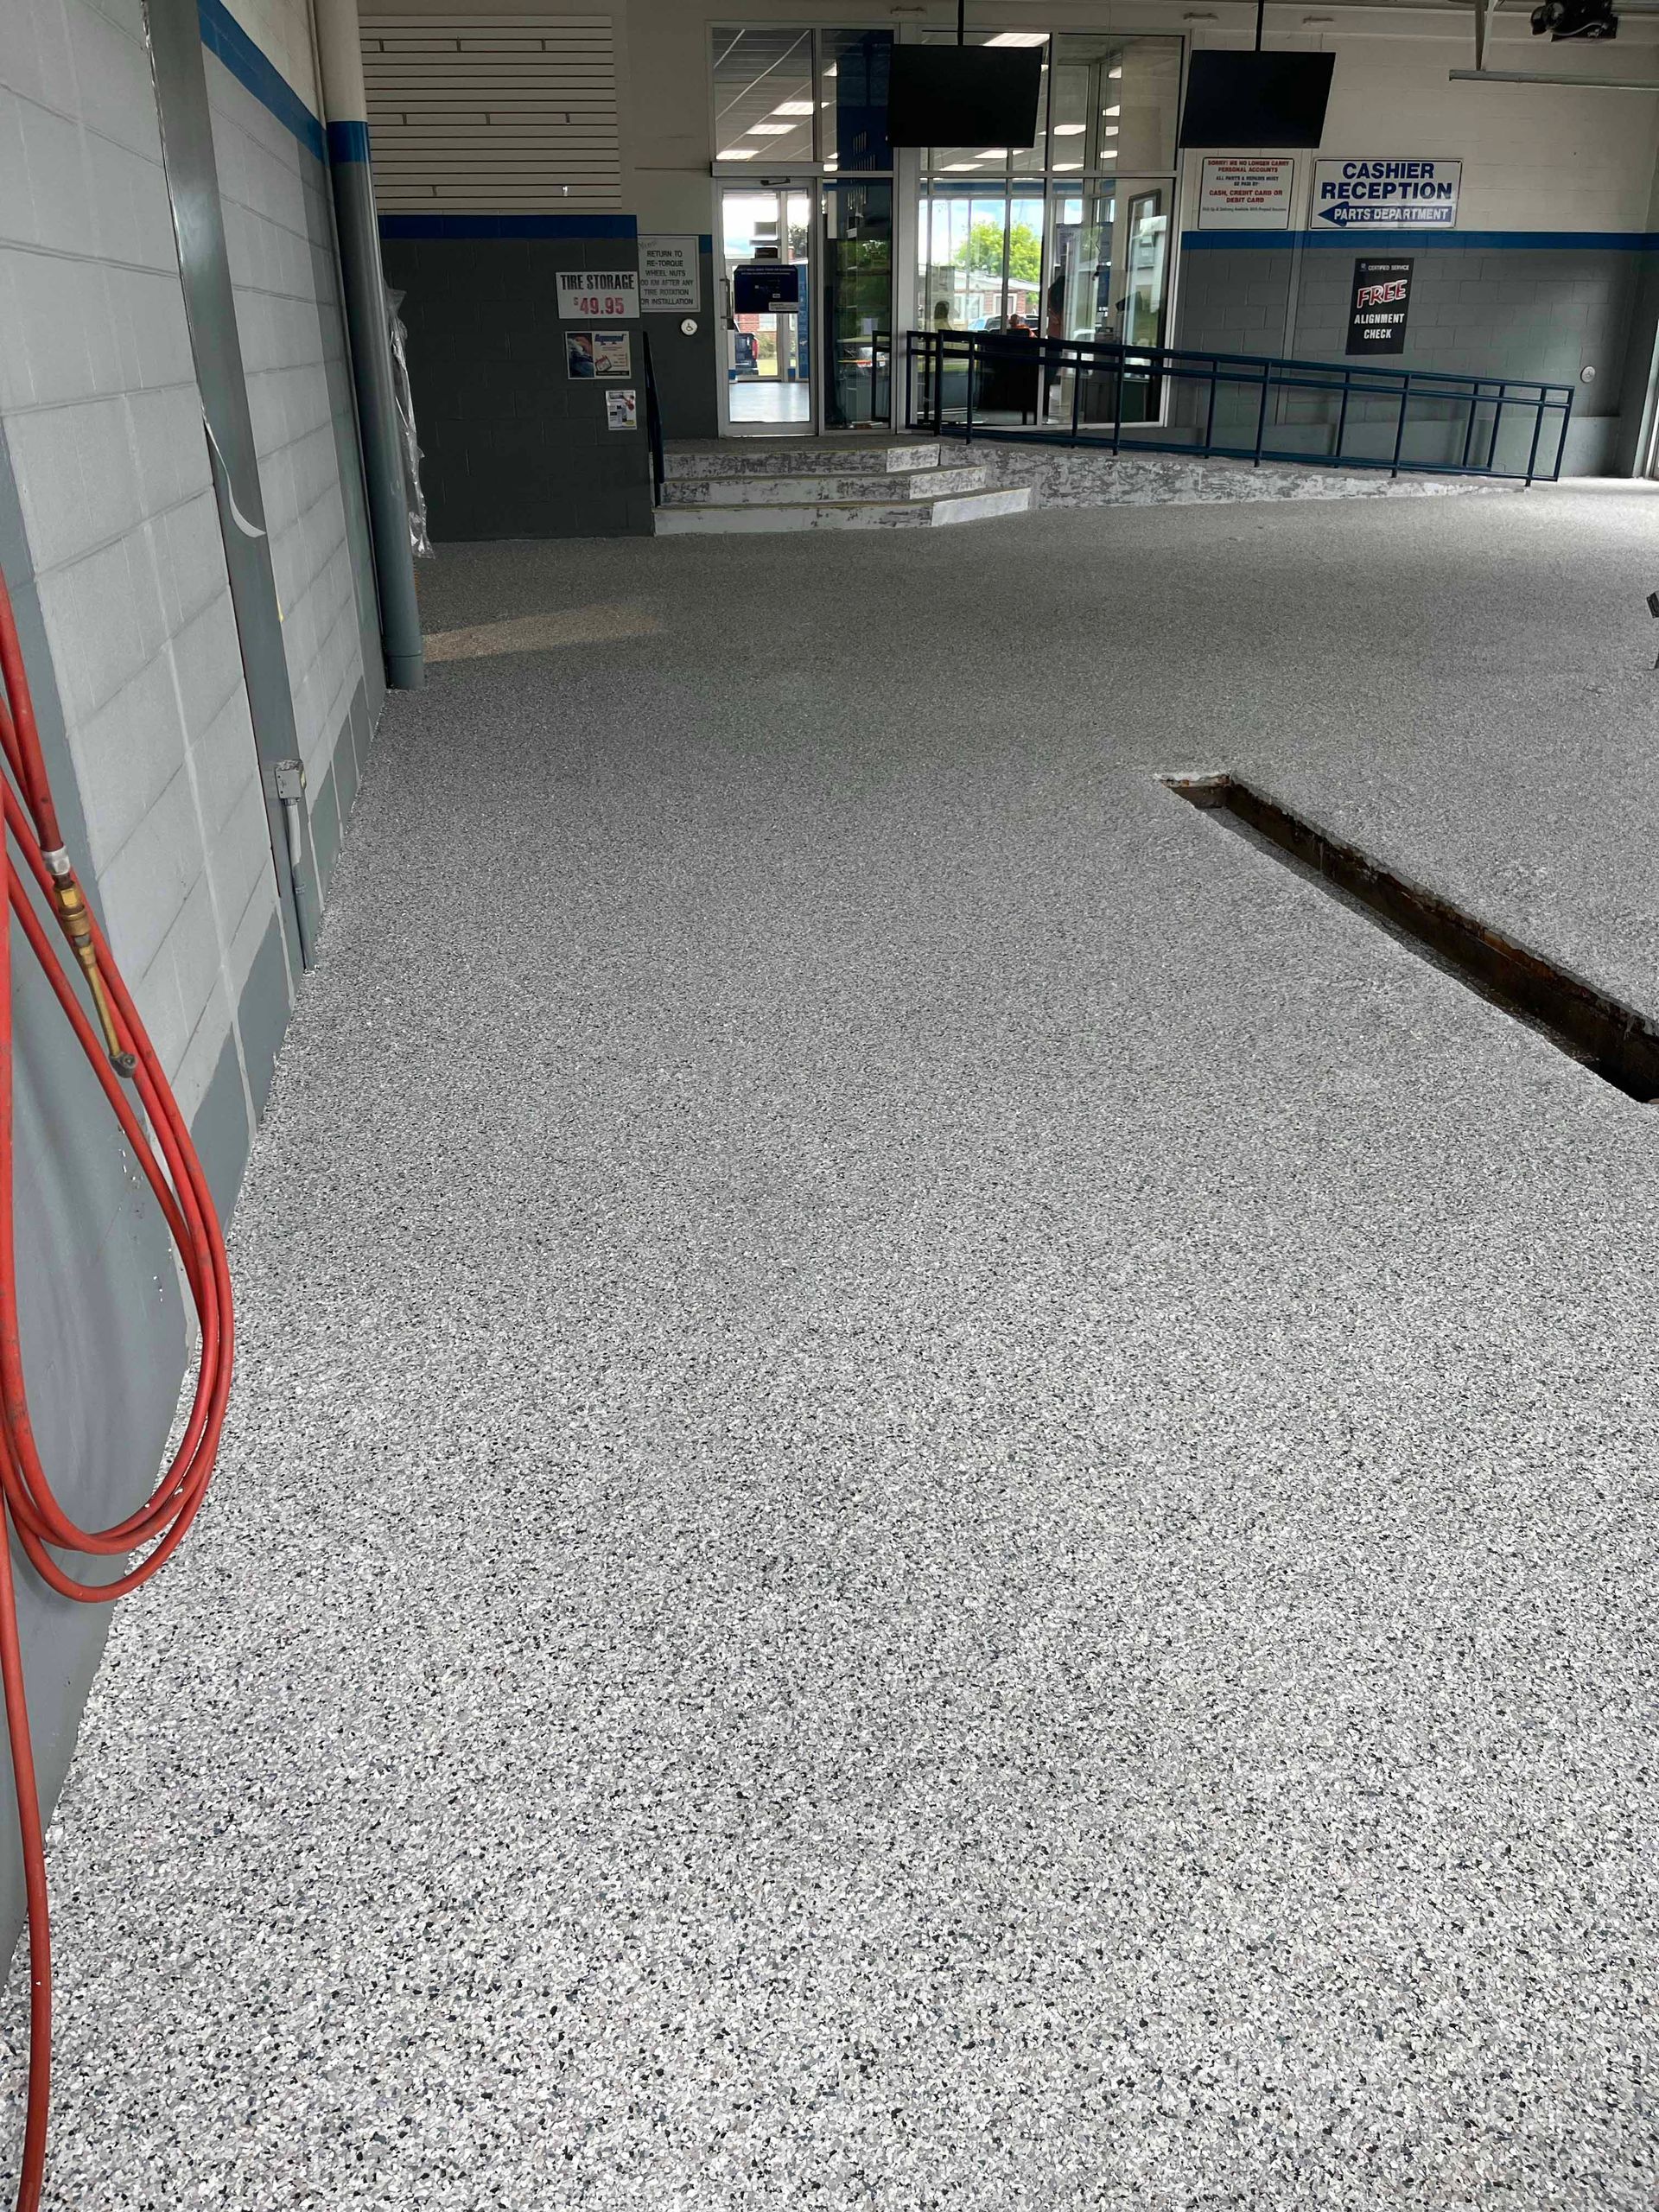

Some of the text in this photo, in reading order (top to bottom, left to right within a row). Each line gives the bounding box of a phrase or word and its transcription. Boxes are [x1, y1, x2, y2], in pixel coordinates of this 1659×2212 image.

[1343, 162, 1434, 179] CASHIER
[1321, 182, 1452, 199] RECEPTION
[1334, 208, 1449, 219] PARTS DEPARTMENT
[560, 274, 635, 290] TIRE STORAGE
[1357, 279, 1408, 308] FREE
[573, 296, 625, 315] $49.95
[1354, 314, 1405, 324] ALIGNMENT
[1363, 328, 1392, 339] CHECK
